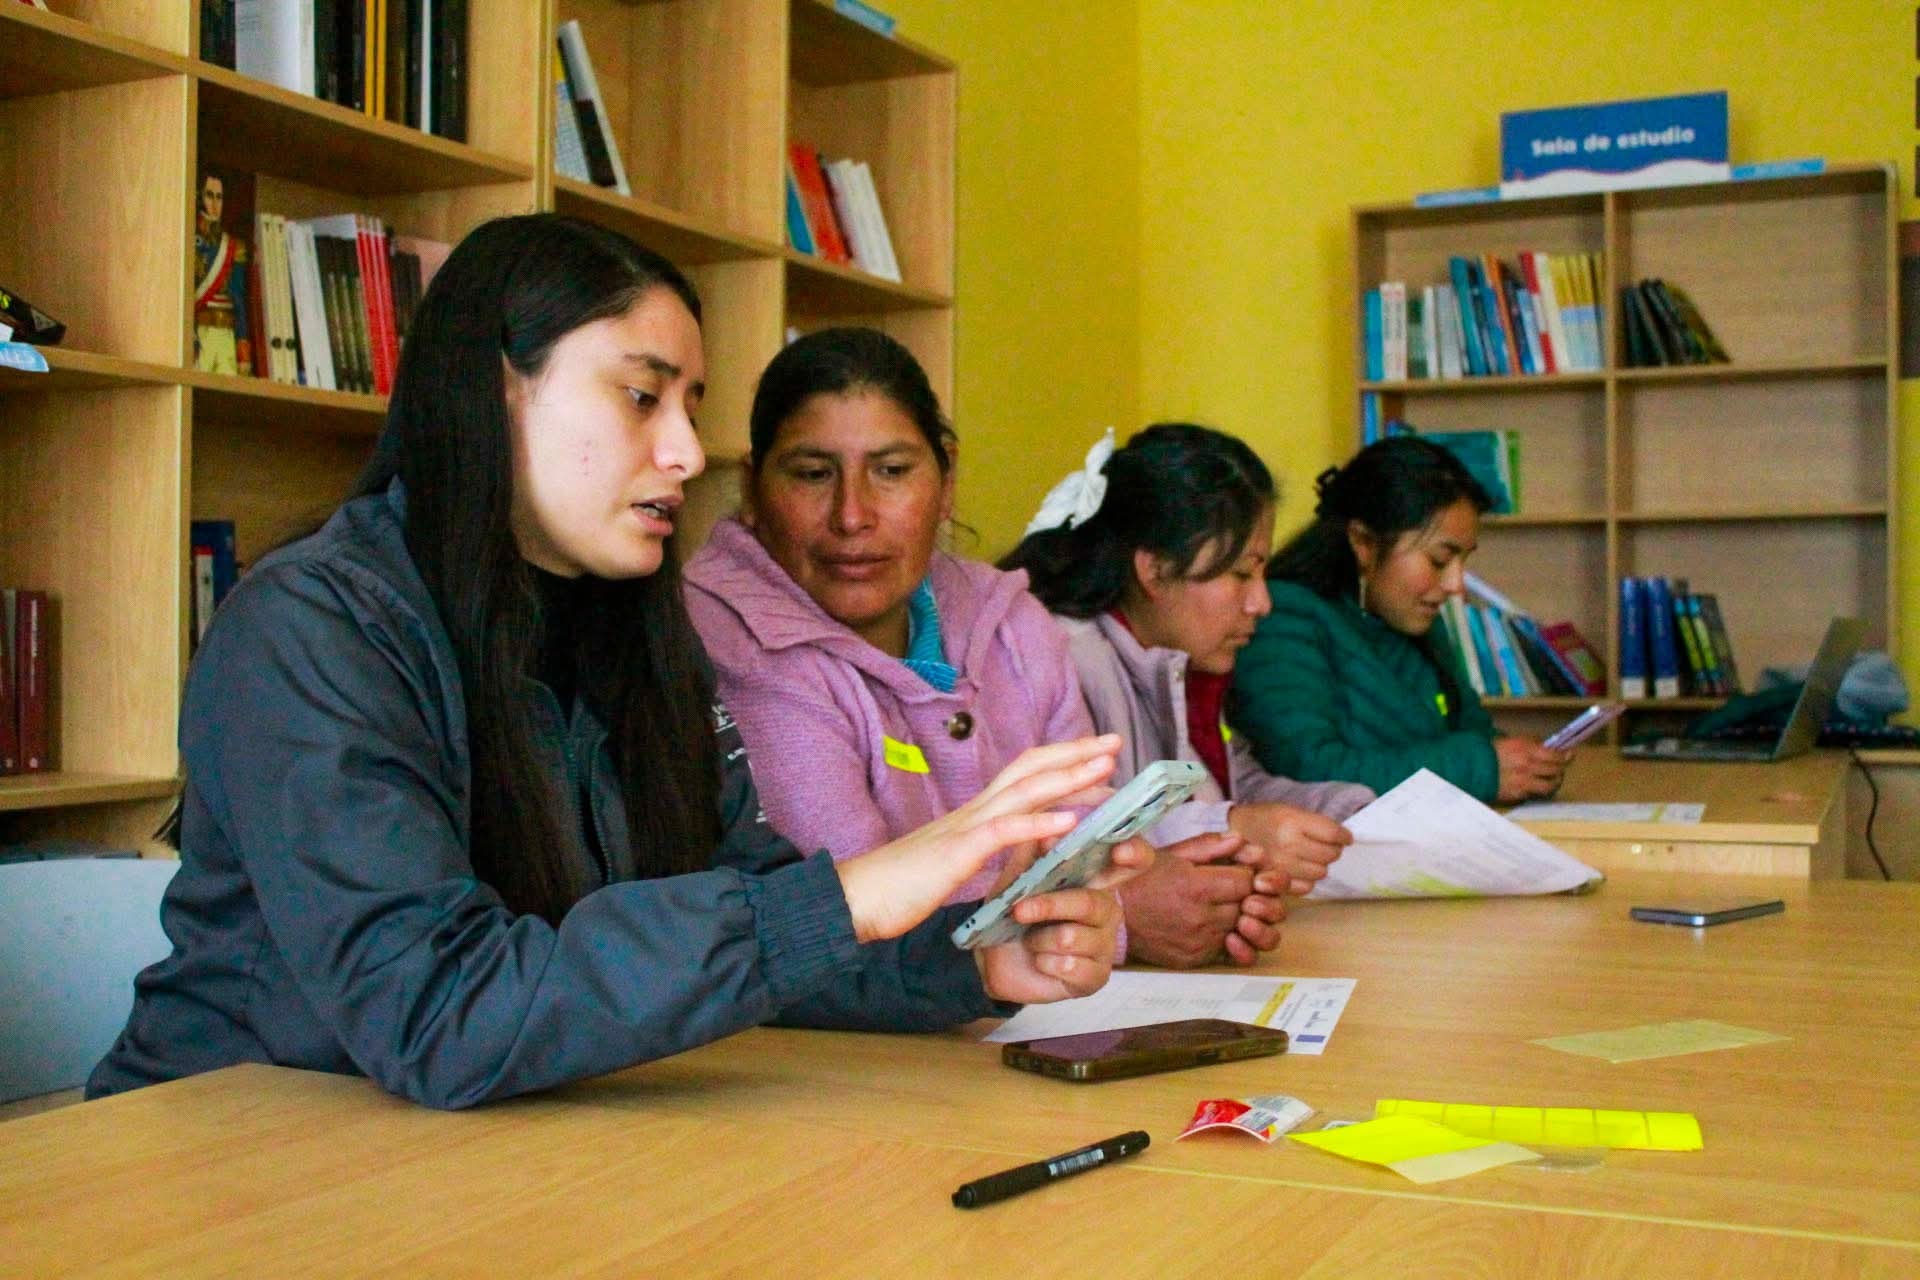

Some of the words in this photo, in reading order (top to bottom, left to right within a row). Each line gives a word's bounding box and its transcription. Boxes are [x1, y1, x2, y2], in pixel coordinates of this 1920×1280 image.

[1531, 137, 1577, 157] Sala
[1583, 132, 1610, 153] de
[1616, 125, 1695, 149] estudio
